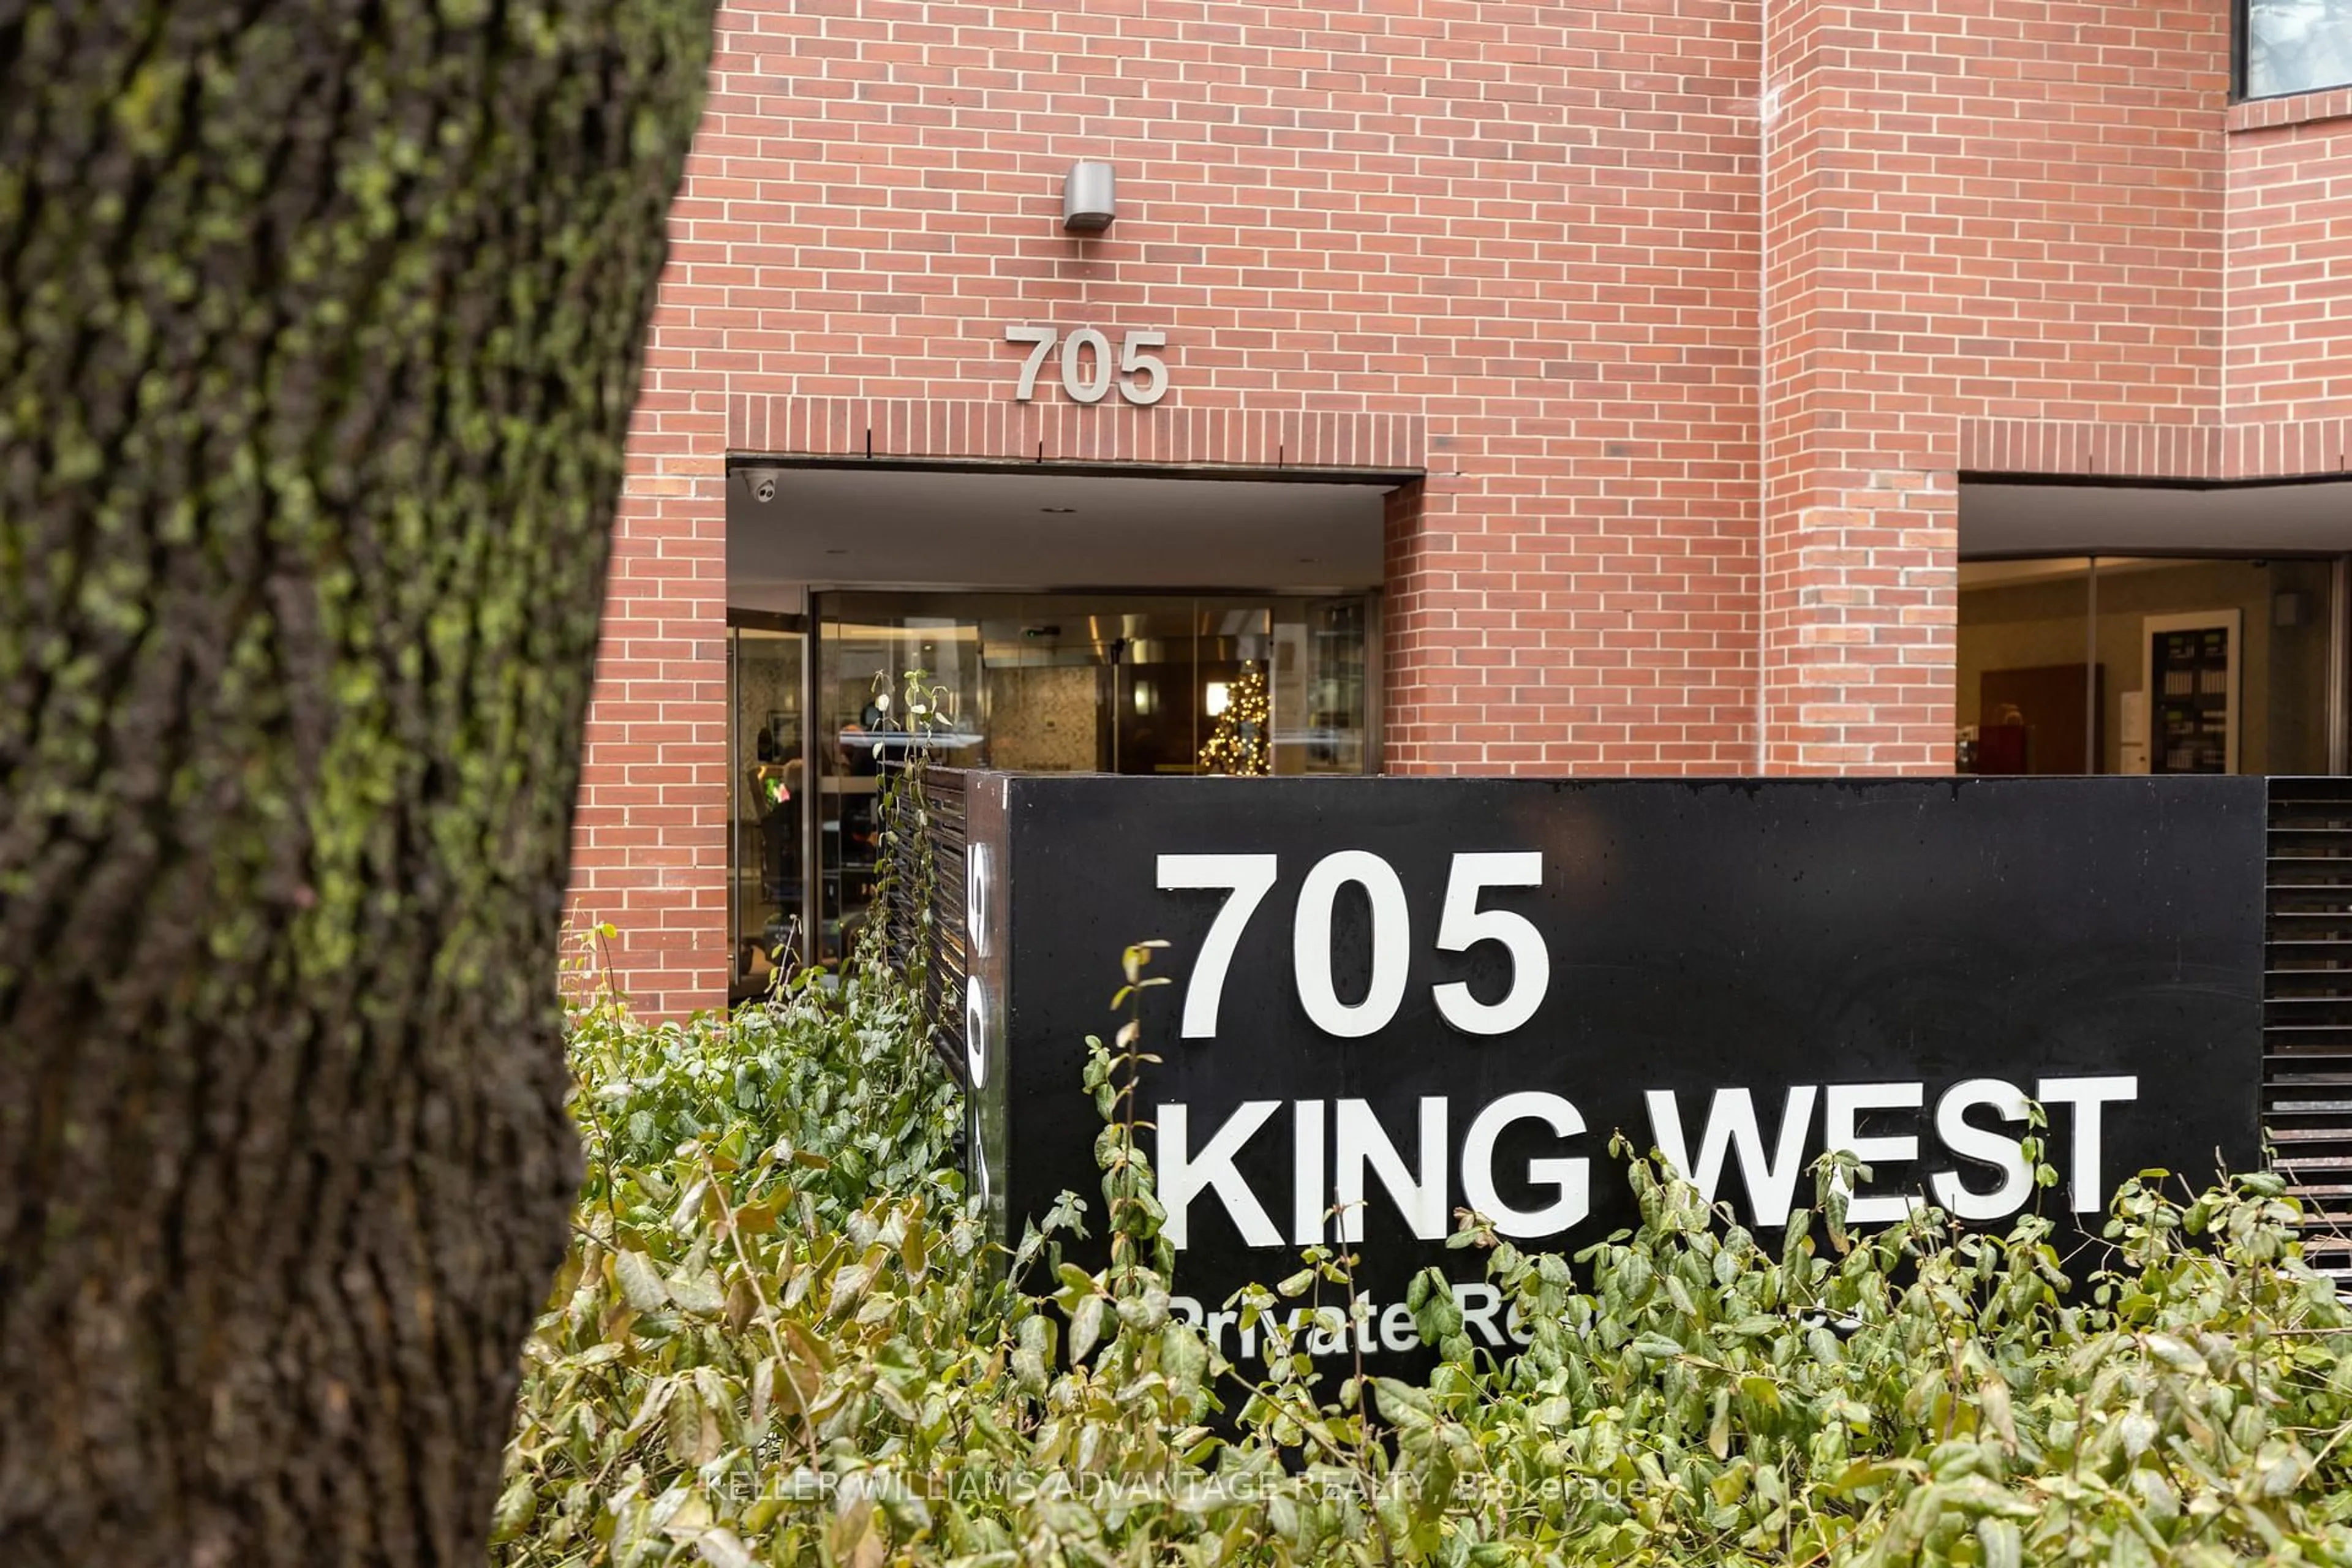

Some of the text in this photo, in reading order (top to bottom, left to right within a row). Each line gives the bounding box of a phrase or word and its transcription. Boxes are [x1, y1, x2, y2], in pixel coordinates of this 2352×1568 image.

[1006, 325, 1169, 405] 705
[1156, 850, 1550, 1039] 705
[1156, 1076, 2138, 1250] KING WEST
